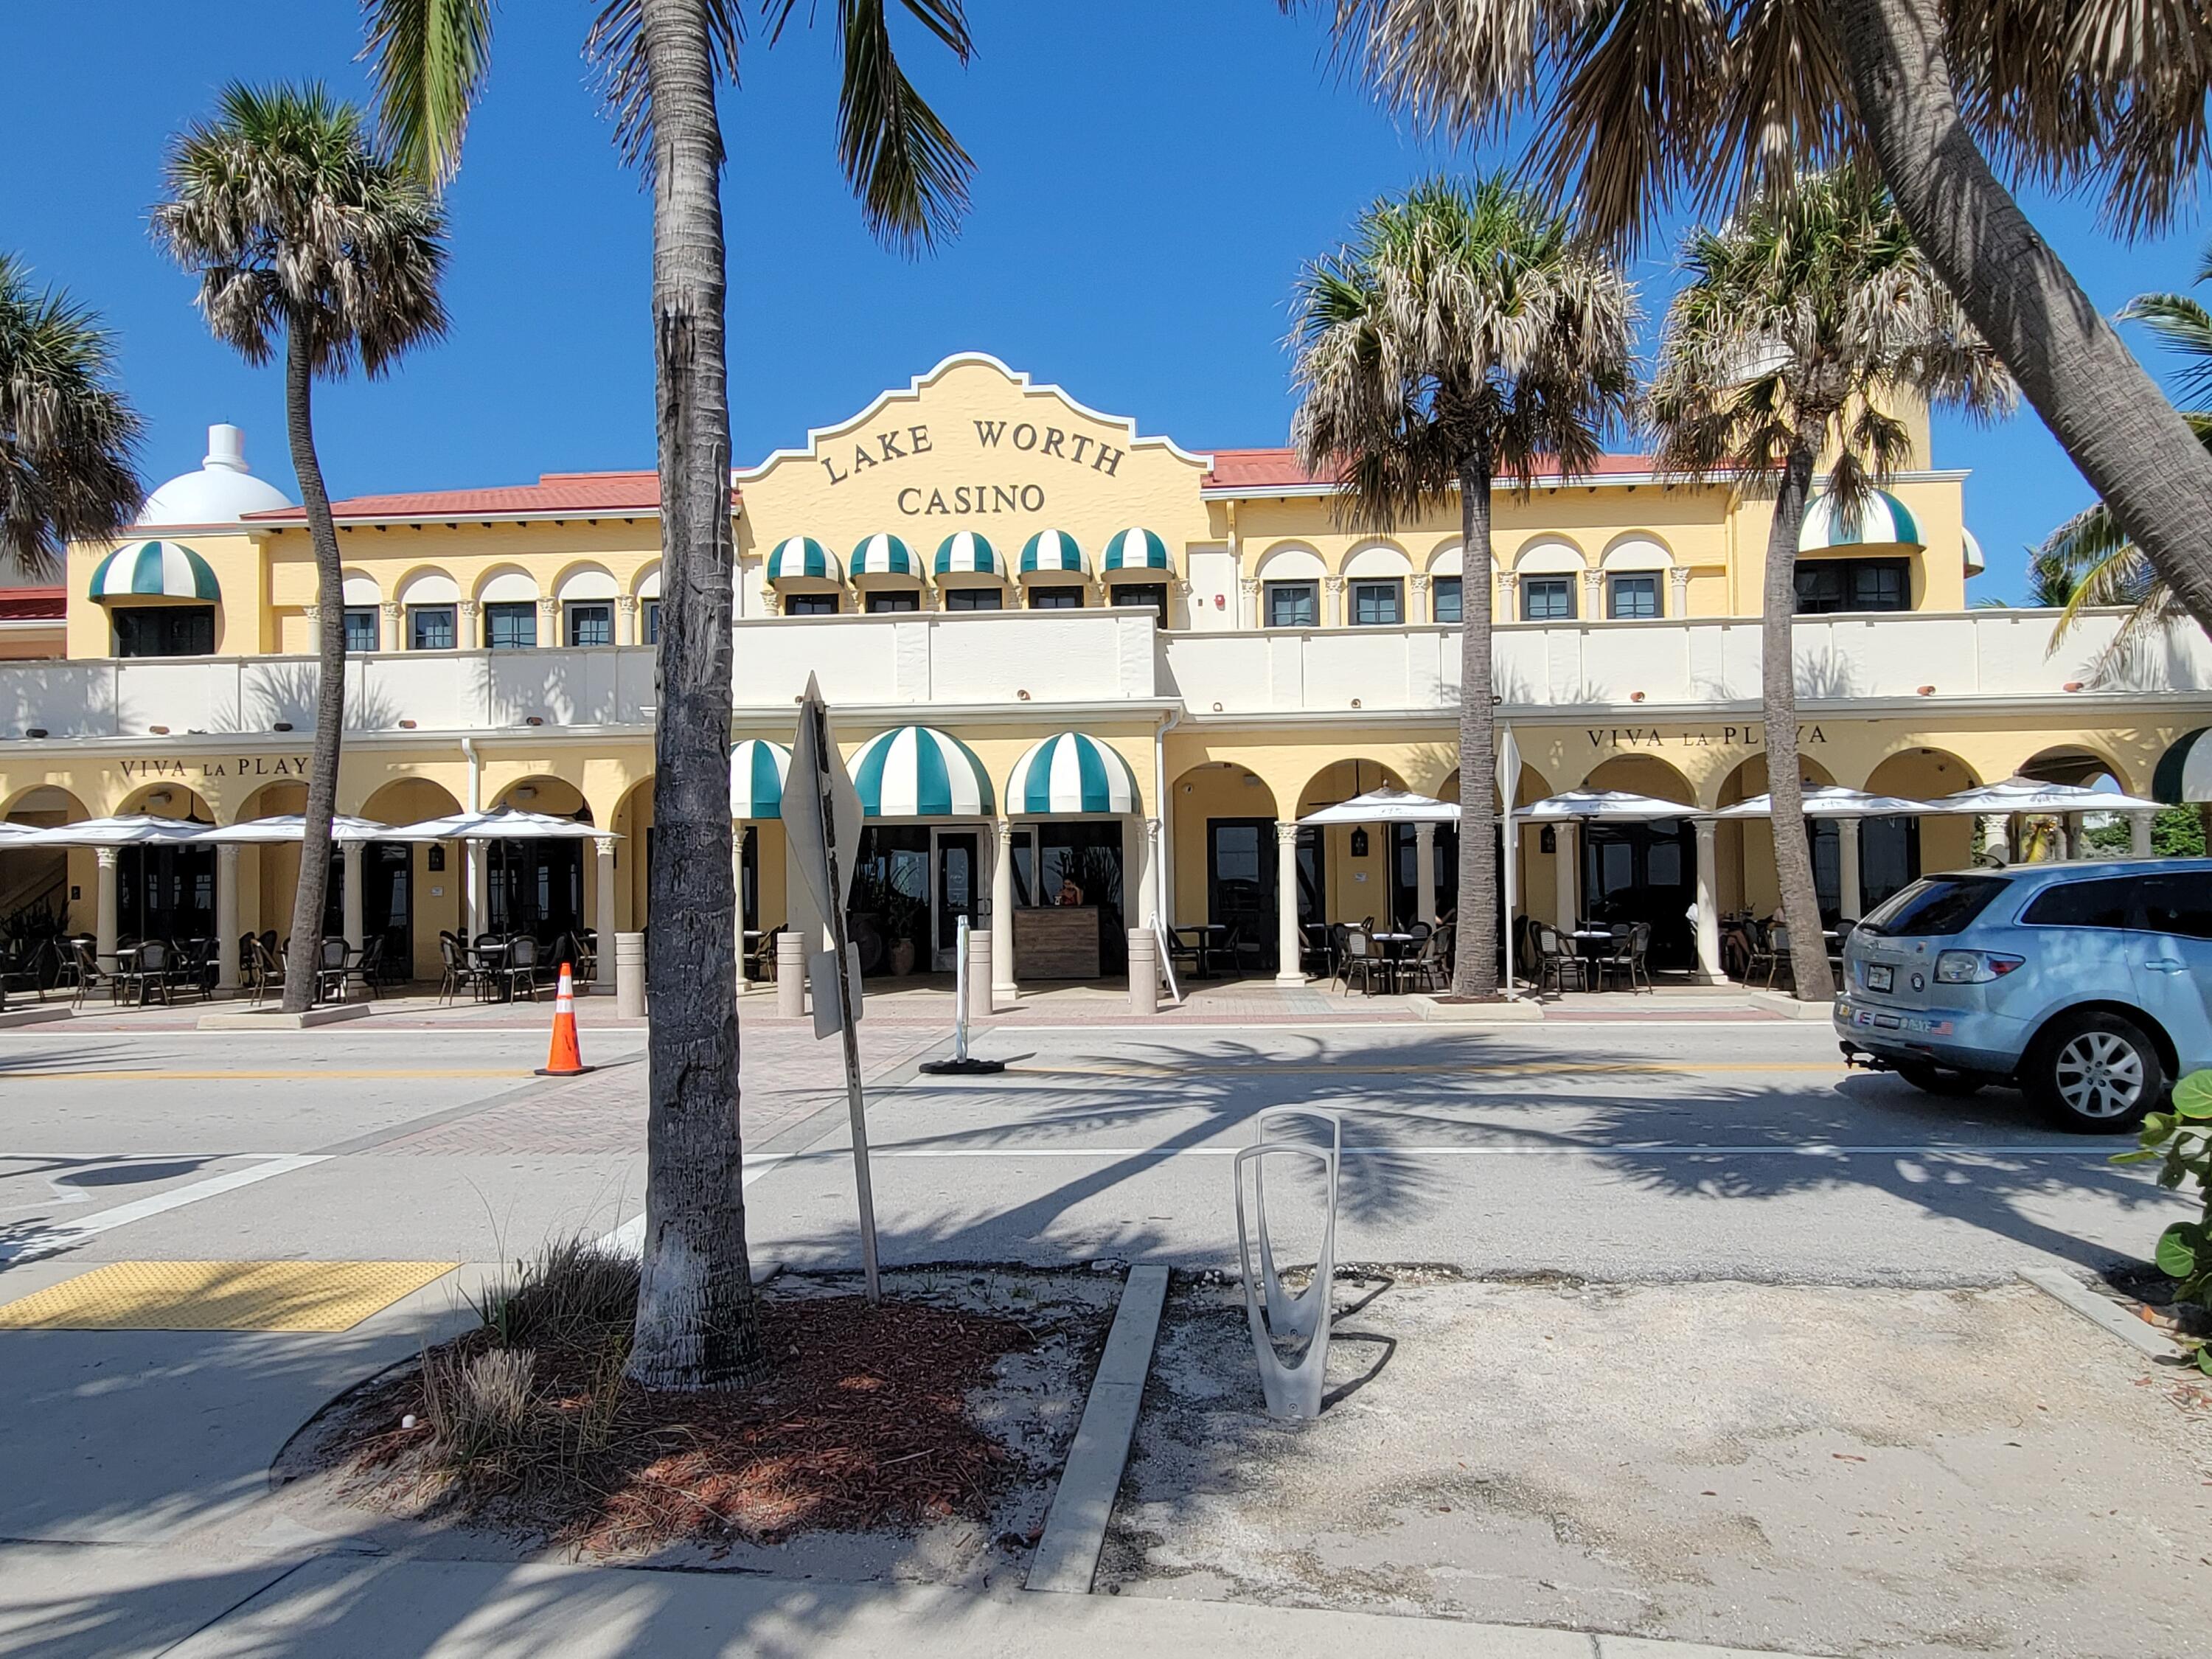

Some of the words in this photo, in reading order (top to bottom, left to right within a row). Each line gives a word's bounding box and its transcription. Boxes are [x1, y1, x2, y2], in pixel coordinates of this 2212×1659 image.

[821, 425, 933, 485] LAKE
[973, 420, 1125, 477] WORTH
[897, 484, 1045, 515] CASINO
[1587, 728, 1663, 747] VIVA
[1682, 733, 1710, 746] LA
[1722, 726, 1827, 745] PLYA
[120, 759, 187, 778] VIVA
[203, 764, 226, 776] LA
[237, 757, 309, 775] PLAY
